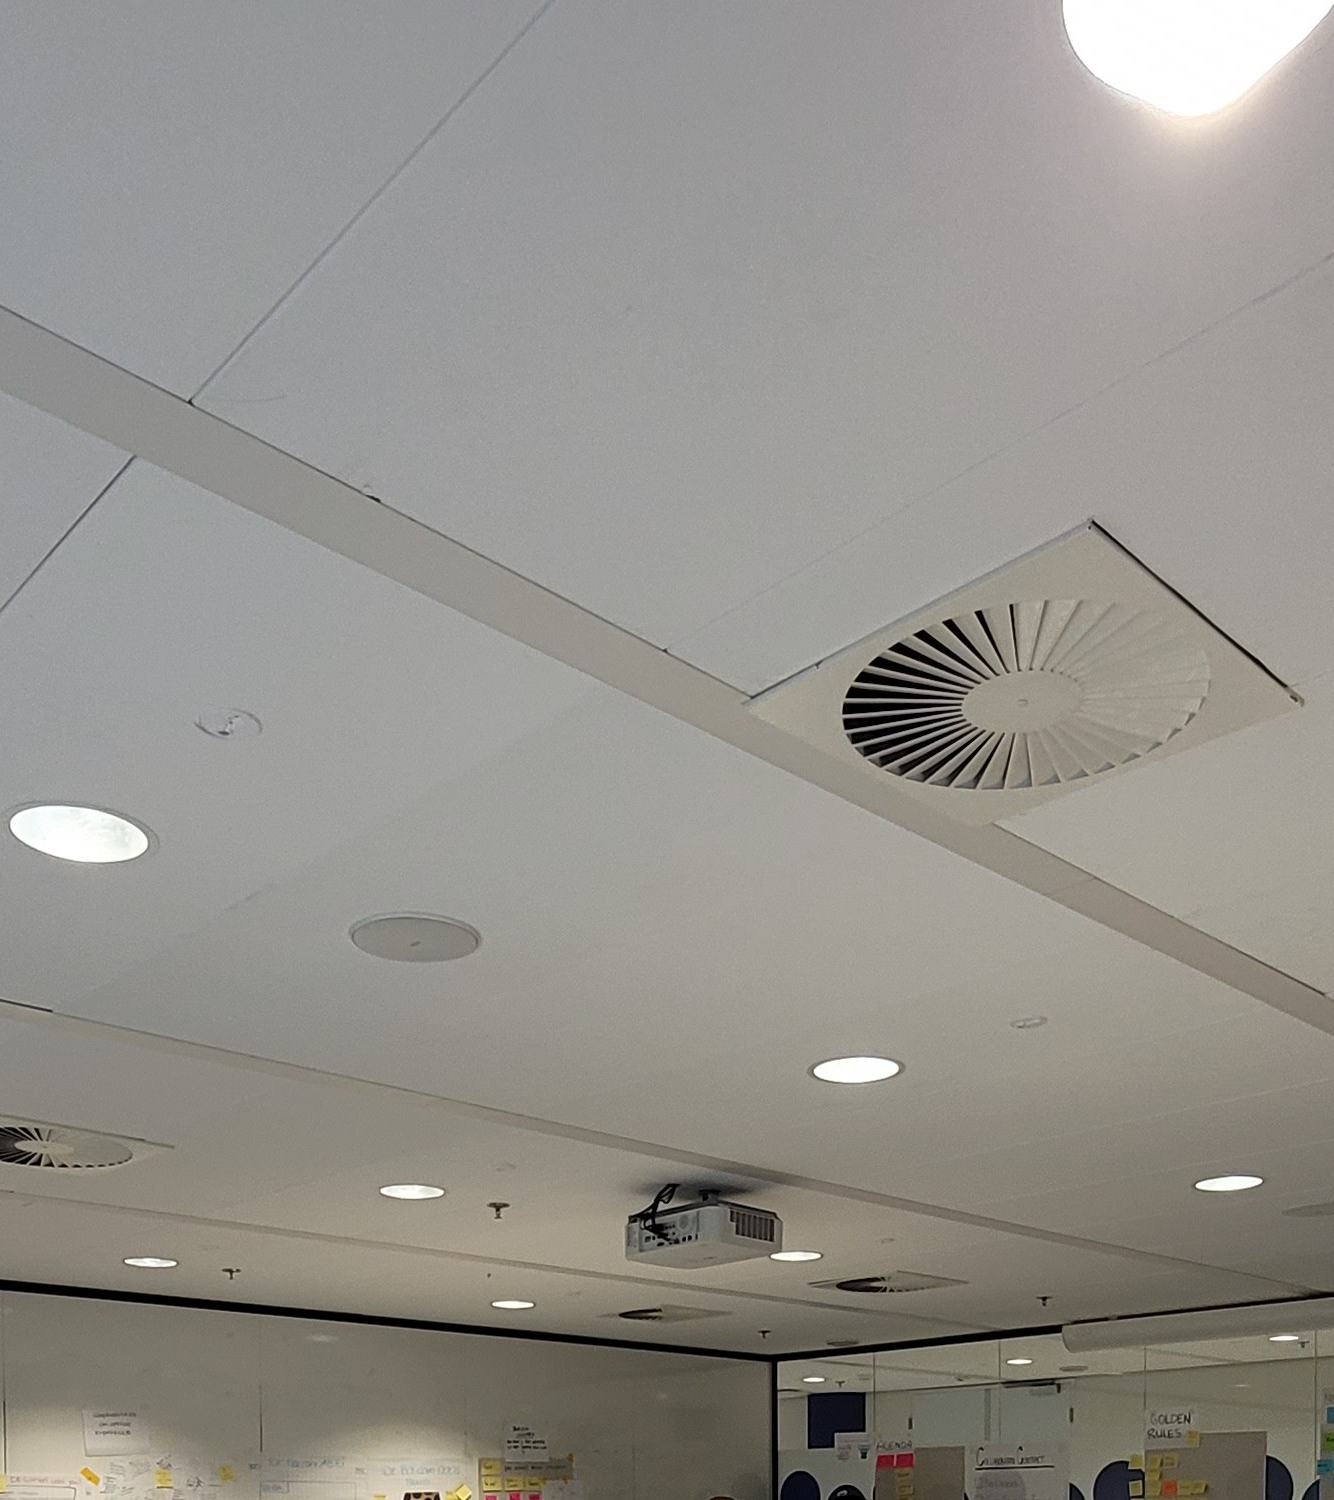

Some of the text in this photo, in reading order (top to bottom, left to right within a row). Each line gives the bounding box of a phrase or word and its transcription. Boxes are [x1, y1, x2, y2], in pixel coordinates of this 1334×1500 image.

[1150, 1413, 1193, 1425] GOLDEN
[1147, 1429, 1182, 1440] RULES
[876, 1440, 913, 1450] AGENDA
